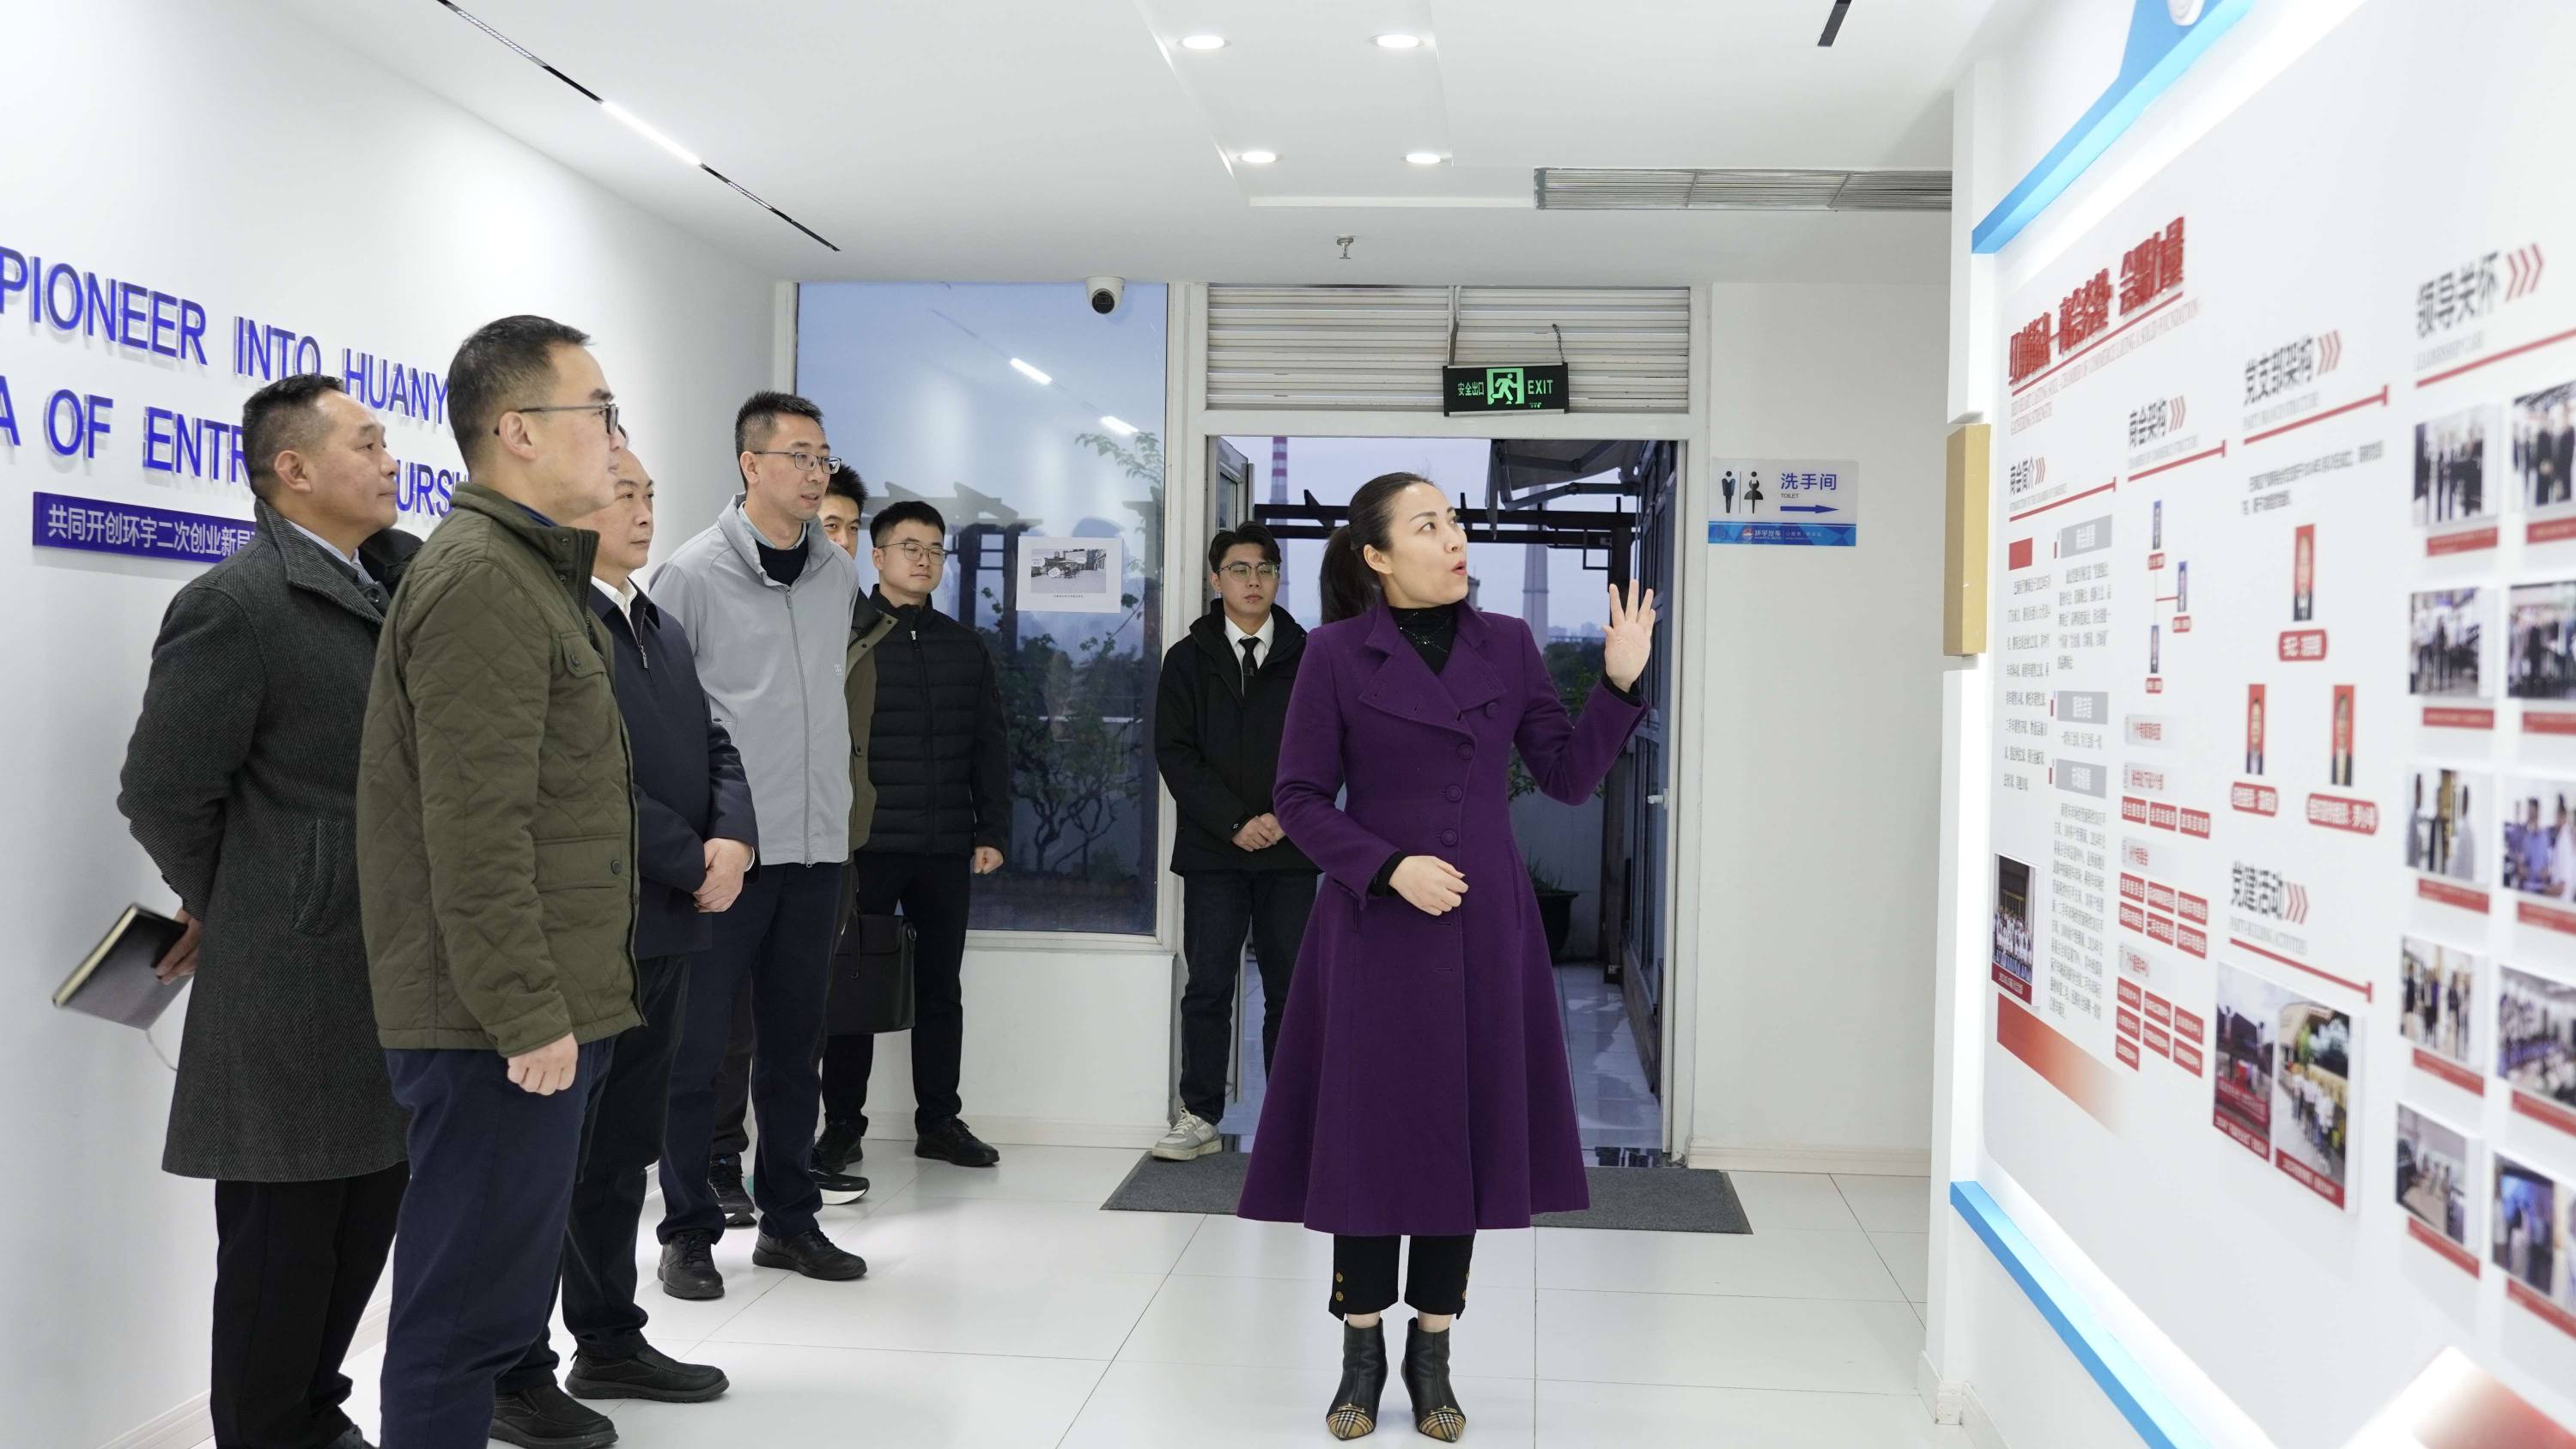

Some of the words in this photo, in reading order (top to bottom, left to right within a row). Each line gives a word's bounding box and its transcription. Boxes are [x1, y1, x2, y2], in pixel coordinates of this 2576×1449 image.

[2417, 252, 2500, 339] 领导关怀
[0, 246, 208, 366] PIONEER
[234, 315, 321, 381] INTO
[343, 348, 449, 424] HUANY
[1457, 381, 1485, 397] 安全出口
[1528, 379, 1553, 395] EXIT
[2243, 336, 2312, 407] 党支部架构
[45, 389, 113, 459] OF
[143, 406, 251, 483] ENTR
[394, 458, 471, 518] URS
[1780, 472, 1837, 490] 洗手间
[48, 503, 256, 557] 共同开创环宇二次创业新局
[2230, 860, 2284, 921] 党建活动
